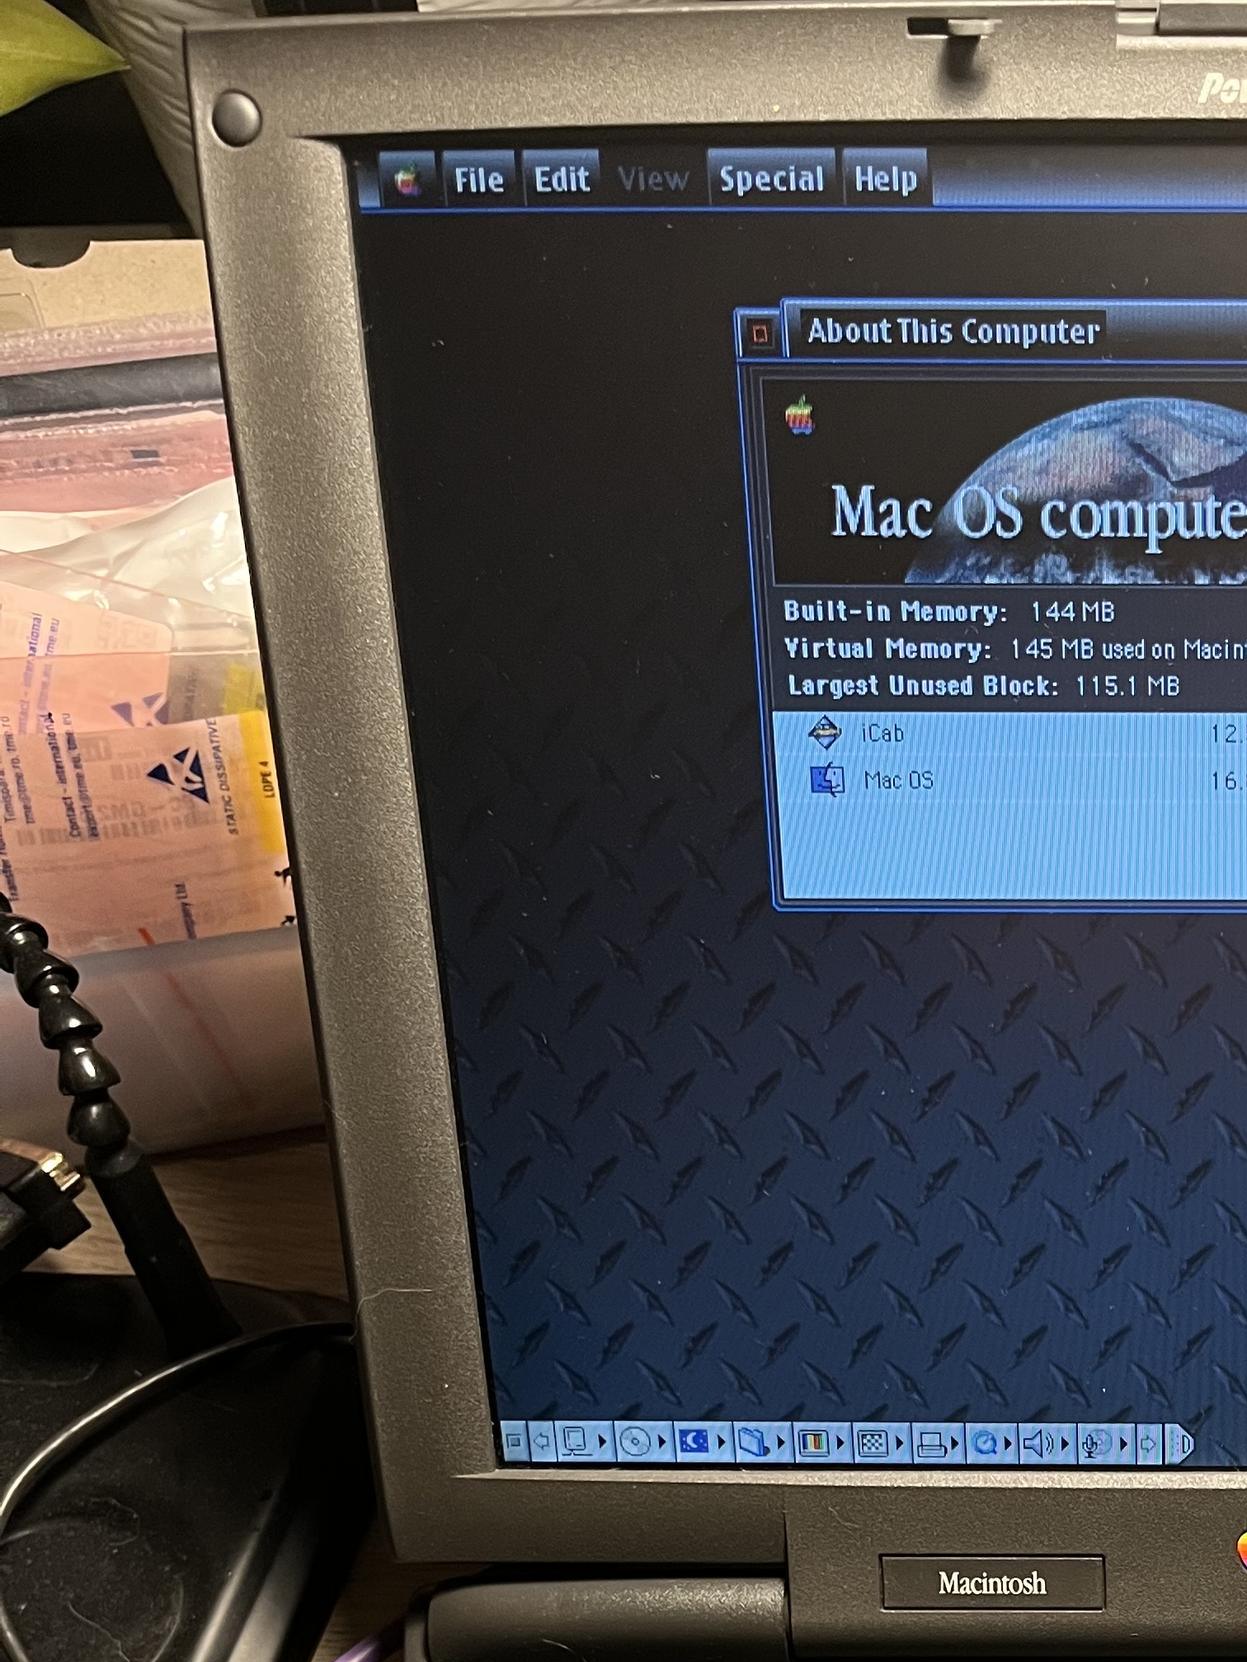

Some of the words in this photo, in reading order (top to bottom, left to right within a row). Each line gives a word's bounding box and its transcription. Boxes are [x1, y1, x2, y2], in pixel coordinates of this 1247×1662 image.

[454, 167, 504, 193] File
[535, 166, 590, 193] Edit
[618, 166, 689, 192] View
[720, 165, 824, 196] Special
[855, 165, 917, 196] Help
[808, 318, 892, 345] About
[899, 318, 954, 345] This
[963, 318, 1099, 349] Computer
[832, 485, 931, 538] Mac
[954, 485, 1024, 538] OS
[784, 600, 890, 622] Built-in
[901, 601, 1008, 626] Memory:
[1033, 601, 1075, 622] 144
[1082, 601, 1116, 622] MB
[784, 637, 874, 660] Virtual
[885, 638, 992, 664] Memory:
[1012, 638, 1054, 660] 145
[1061, 638, 1094, 660] MB
[1102, 638, 1145, 660] used
[1151, 644, 1175, 660] on
[789, 675, 879, 700] Largest
[889, 675, 973, 697] Unused
[983, 675, 1059, 697] Block:
[1077, 675, 1136, 697] 115.1
[1148, 675, 1180, 697] MB
[862, 723, 904, 743] iCab
[41, 713, 67, 784] international
[205, 718, 231, 791] DISSIPATIVE
[260, 770, 275, 798] LDPE
[865, 770, 902, 789] Mac
[909, 770, 934, 789] OS
[66, 796, 82, 838] Contact
[222, 798, 239, 836] STATIC
[938, 1571, 1047, 1595] Macintosh
